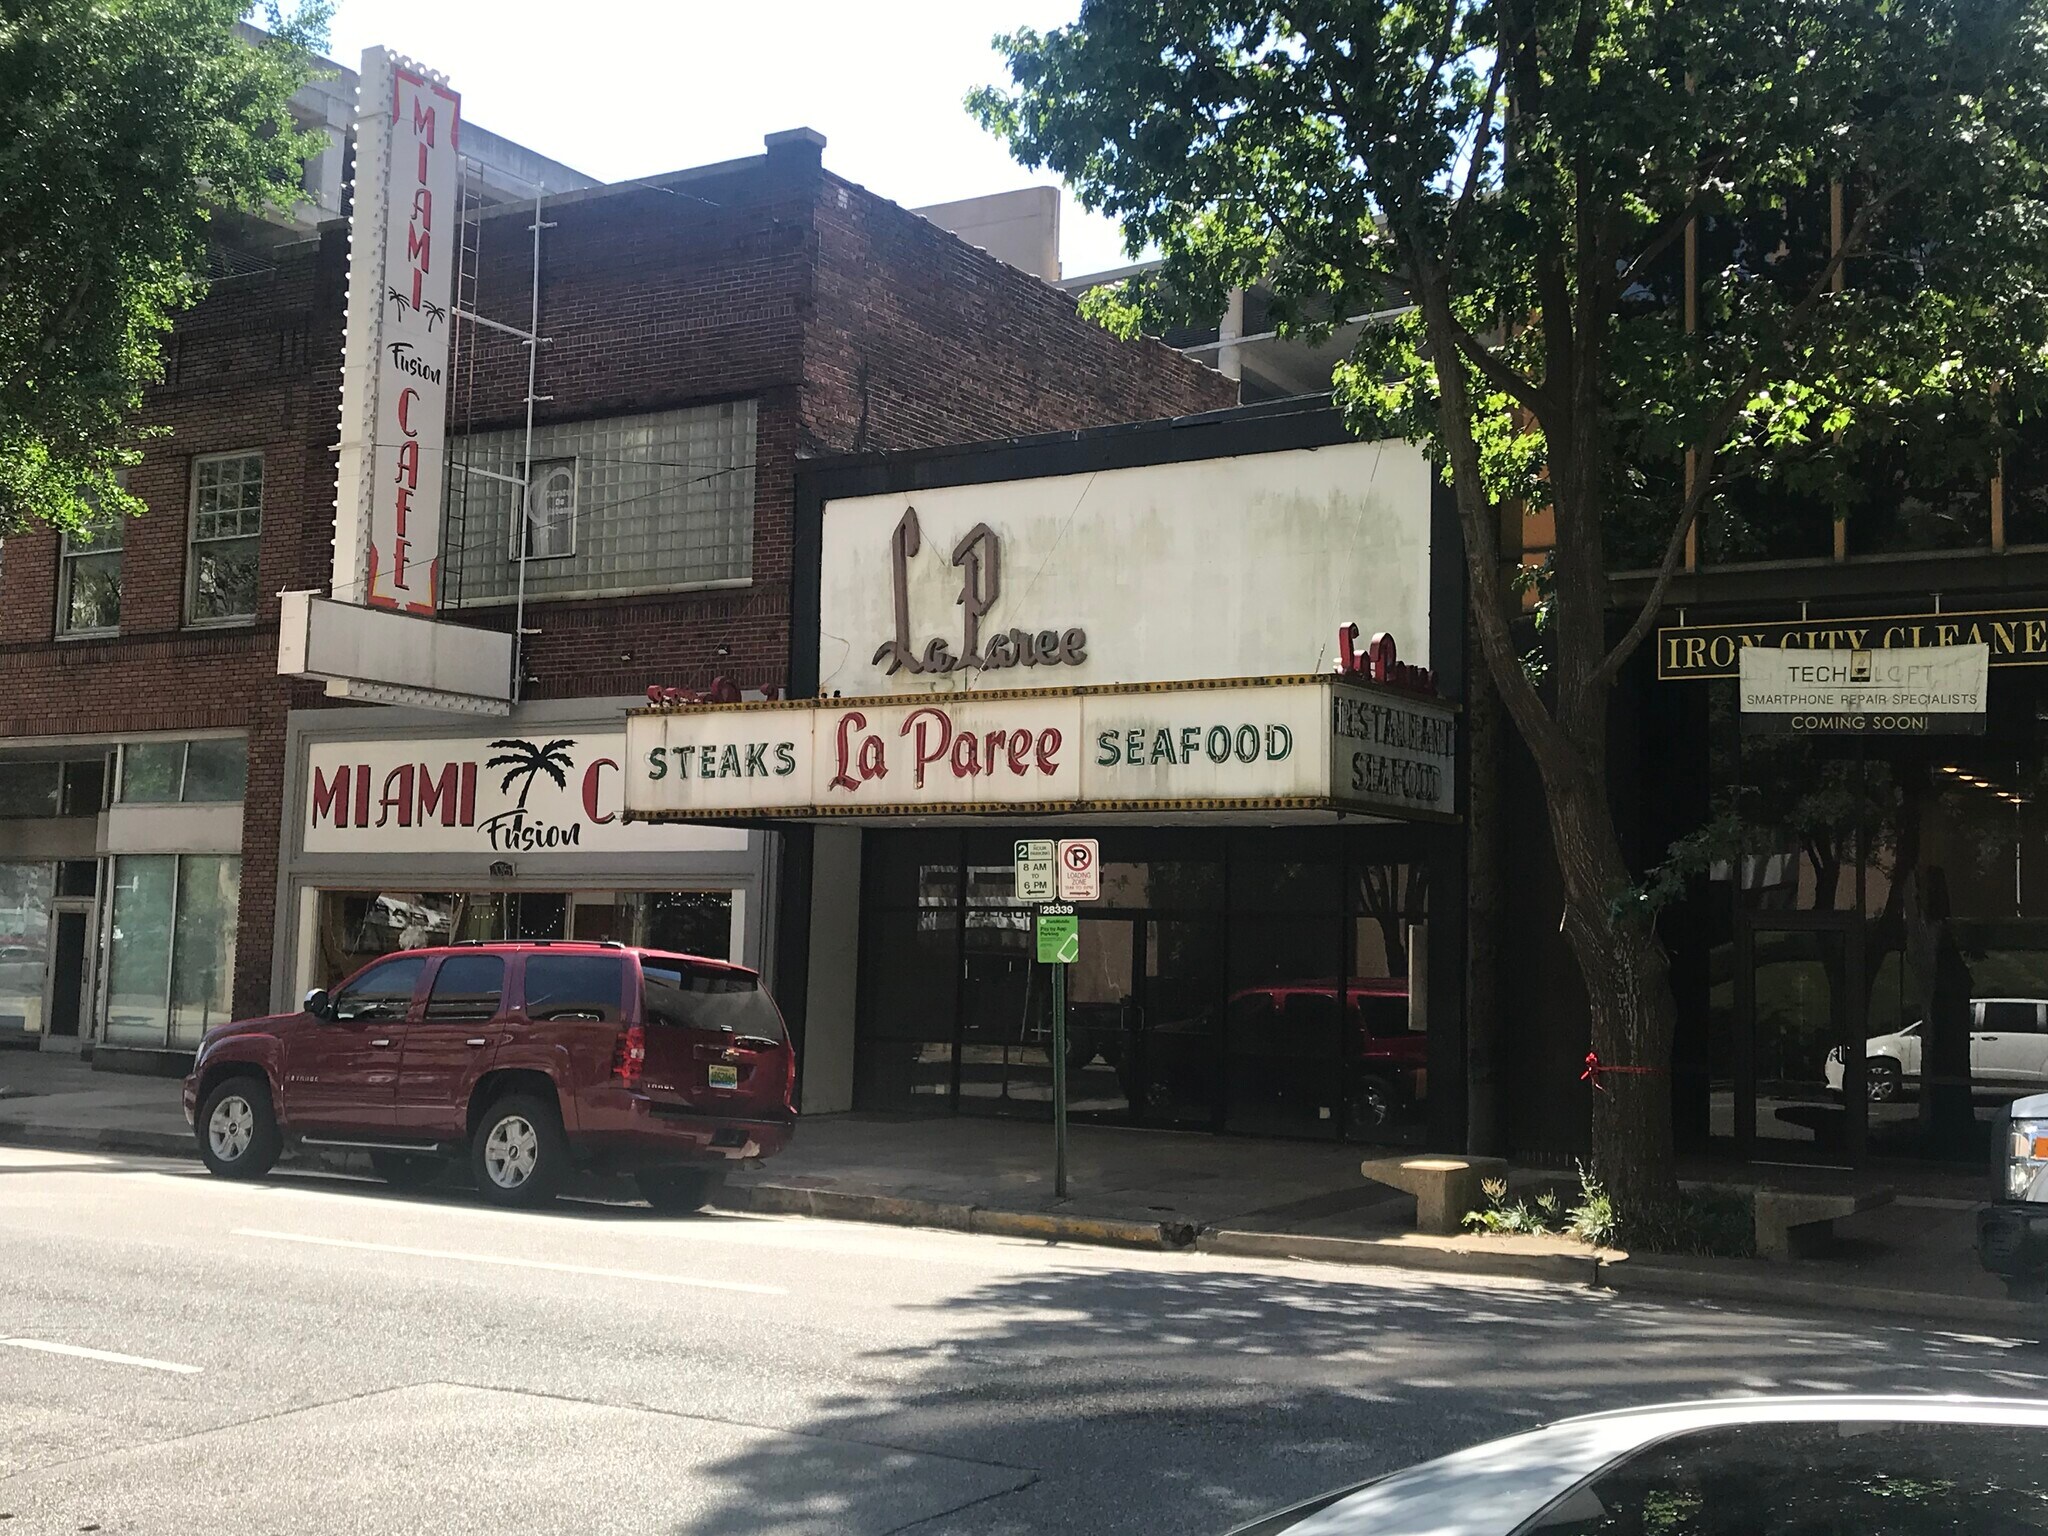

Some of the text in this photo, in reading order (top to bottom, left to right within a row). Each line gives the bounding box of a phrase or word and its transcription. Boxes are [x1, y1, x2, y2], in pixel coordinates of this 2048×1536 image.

[407, 95, 434, 311] MIAMI
[387, 342, 441, 386] Fusion
[393, 387, 420, 590] CAFE
[871, 505, 1087, 675] La Paree
[1788, 666, 1847, 682] TECH
[1747, 693, 1977, 705] SMARTPHONE REPAIR SPECIALISTS
[1791, 716, 1928, 730] COMING SOON!
[648, 742, 796, 780] STEAKS
[829, 707, 1062, 792] La Paree
[1097, 723, 1293, 767] SEAFOOD
[312, 761, 478, 828] MIAMI
[1352, 752, 1442, 801] SEAFOOD
[477, 808, 580, 851] Fusion
[1018, 845, 1028, 858] 2
[1023, 863, 1047, 871] 8 AM
[1024, 881, 1047, 889] 6 PM
